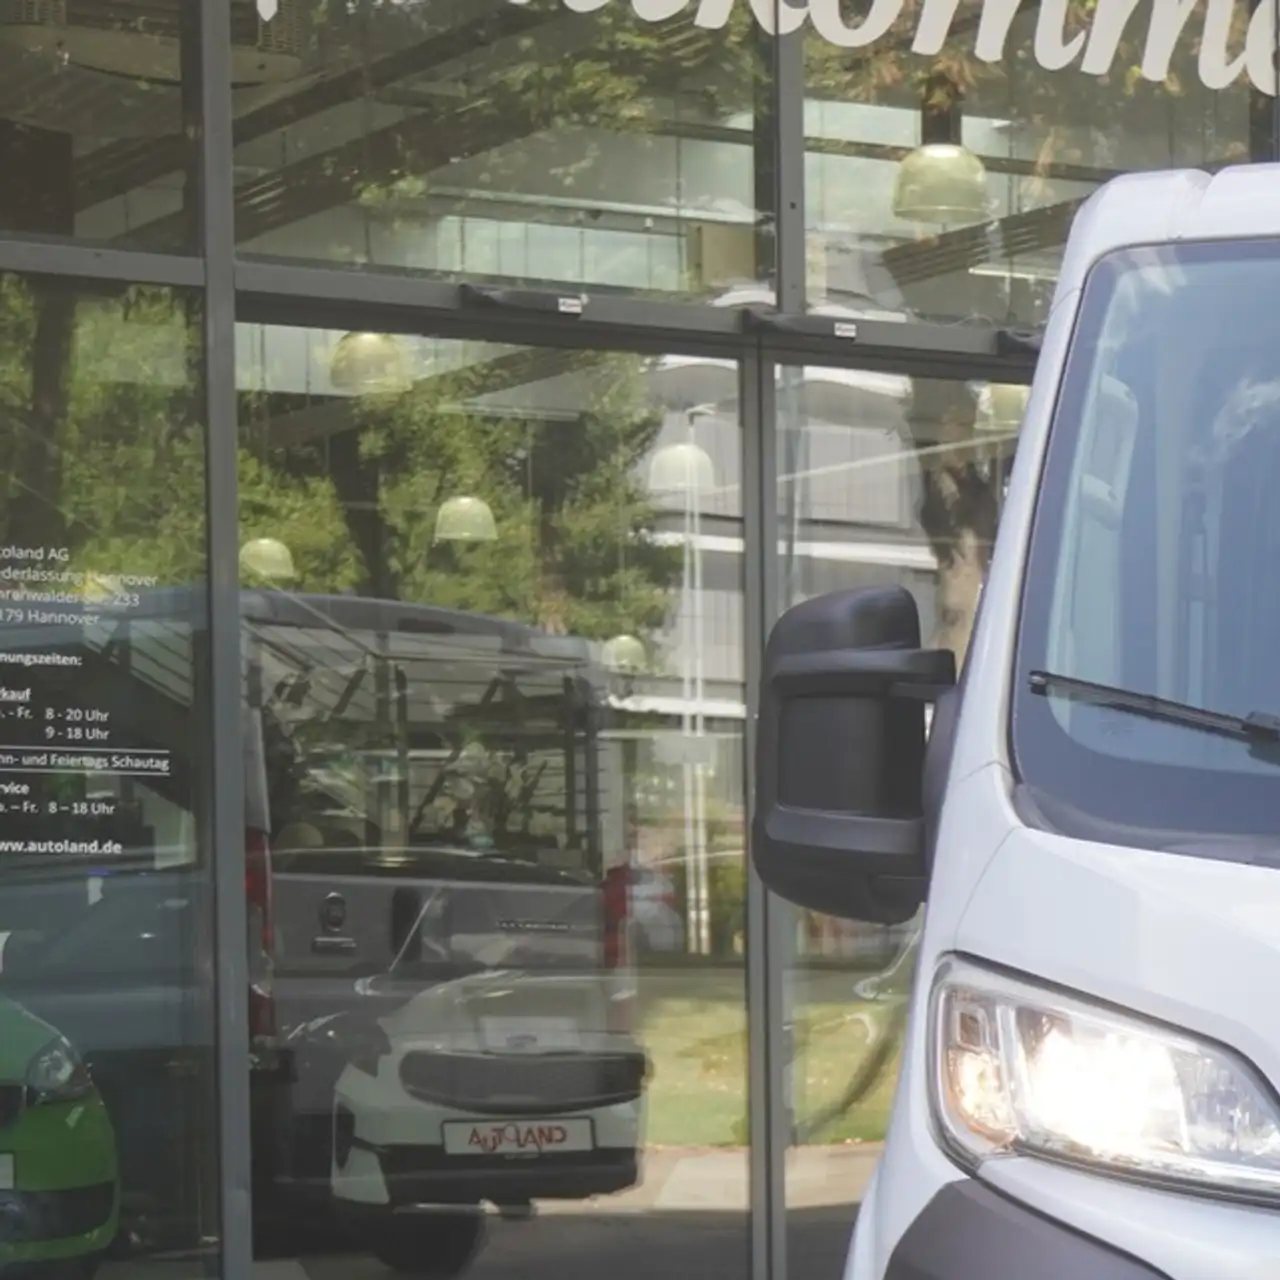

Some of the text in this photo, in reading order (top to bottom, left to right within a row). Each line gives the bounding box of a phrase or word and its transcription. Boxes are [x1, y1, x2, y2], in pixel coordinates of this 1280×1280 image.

[0, 545, 69, 561] oland AG
[0, 566, 84, 587] derlassung
[28, 609, 99, 626] Hannover
[0, 687, 31, 701] kauf
[45, 708, 54, 720] 8
[66, 708, 82, 721] 20
[85, 709, 109, 722] Uhr
[45, 726, 55, 739] 9
[67, 727, 82, 740] 18
[85, 728, 109, 740] Uhr
[22, 753, 47, 766] und
[50, 753, 108, 769] Feiertags
[111, 755, 169, 772] Schautag
[48, 802, 57, 814] 8
[73, 803, 88, 815] 18
[91, 804, 115, 815] Uhr
